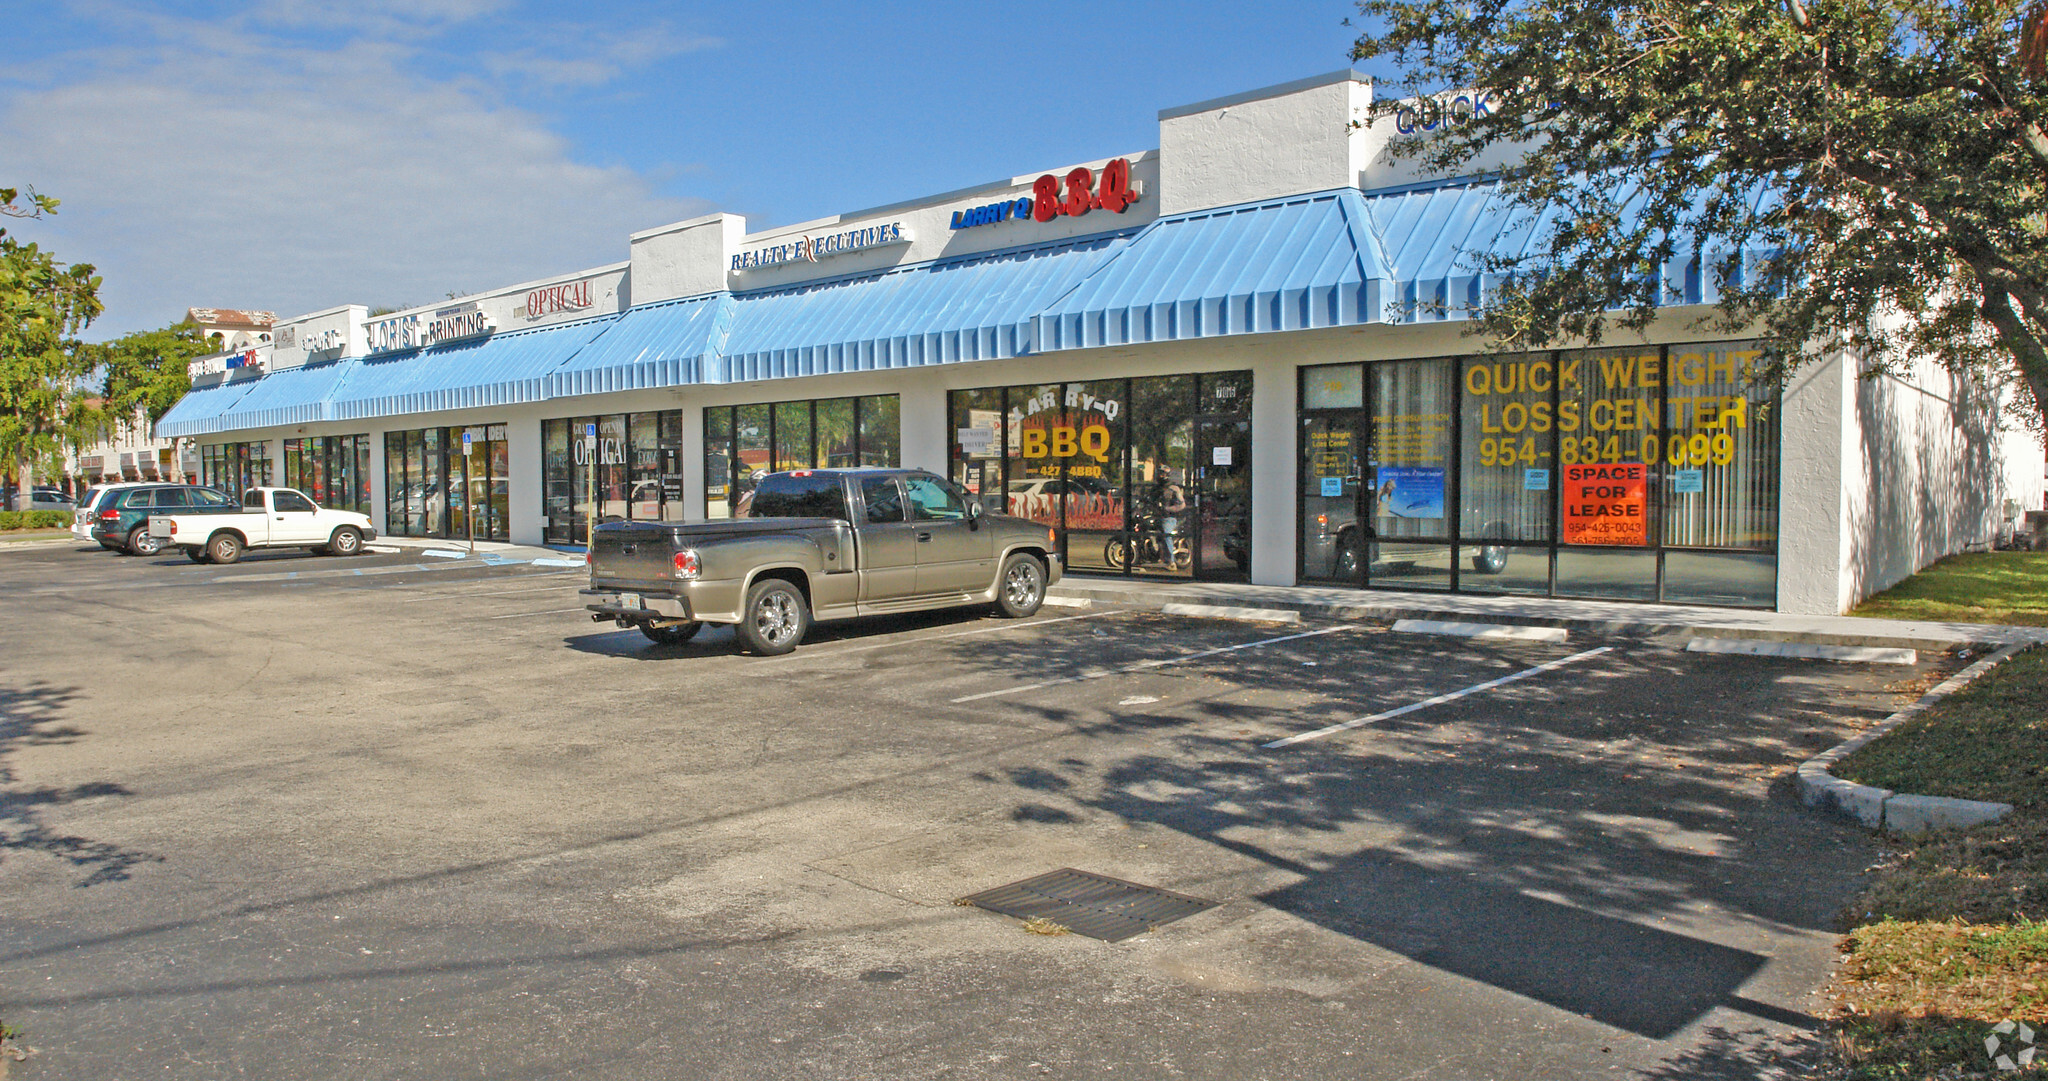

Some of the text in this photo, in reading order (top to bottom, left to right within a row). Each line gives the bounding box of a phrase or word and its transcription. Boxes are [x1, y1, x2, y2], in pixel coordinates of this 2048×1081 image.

[950, 158, 1137, 230] LARRY Q B.B.Q.
[731, 222, 900, 271] REALTY EXECUTIVES
[527, 281, 592, 316] OPTICAL
[429, 311, 484, 342] PRINTING
[1466, 350, 1762, 395] QUICK WEIGHT
[1011, 389, 1119, 422] LARRY-Q
[1216, 386, 1236, 398] 706
[600, 420, 625, 434] OPENIN
[1481, 396, 1747, 433] LOSS CENTER
[1022, 424, 1111, 463] BBQ
[1569, 467, 1641, 481] SPACE
[1581, 486, 1627, 498] FOR
[1569, 504, 1640, 517] LEASE
[1568, 523, 1641, 533] 954-426-0043
